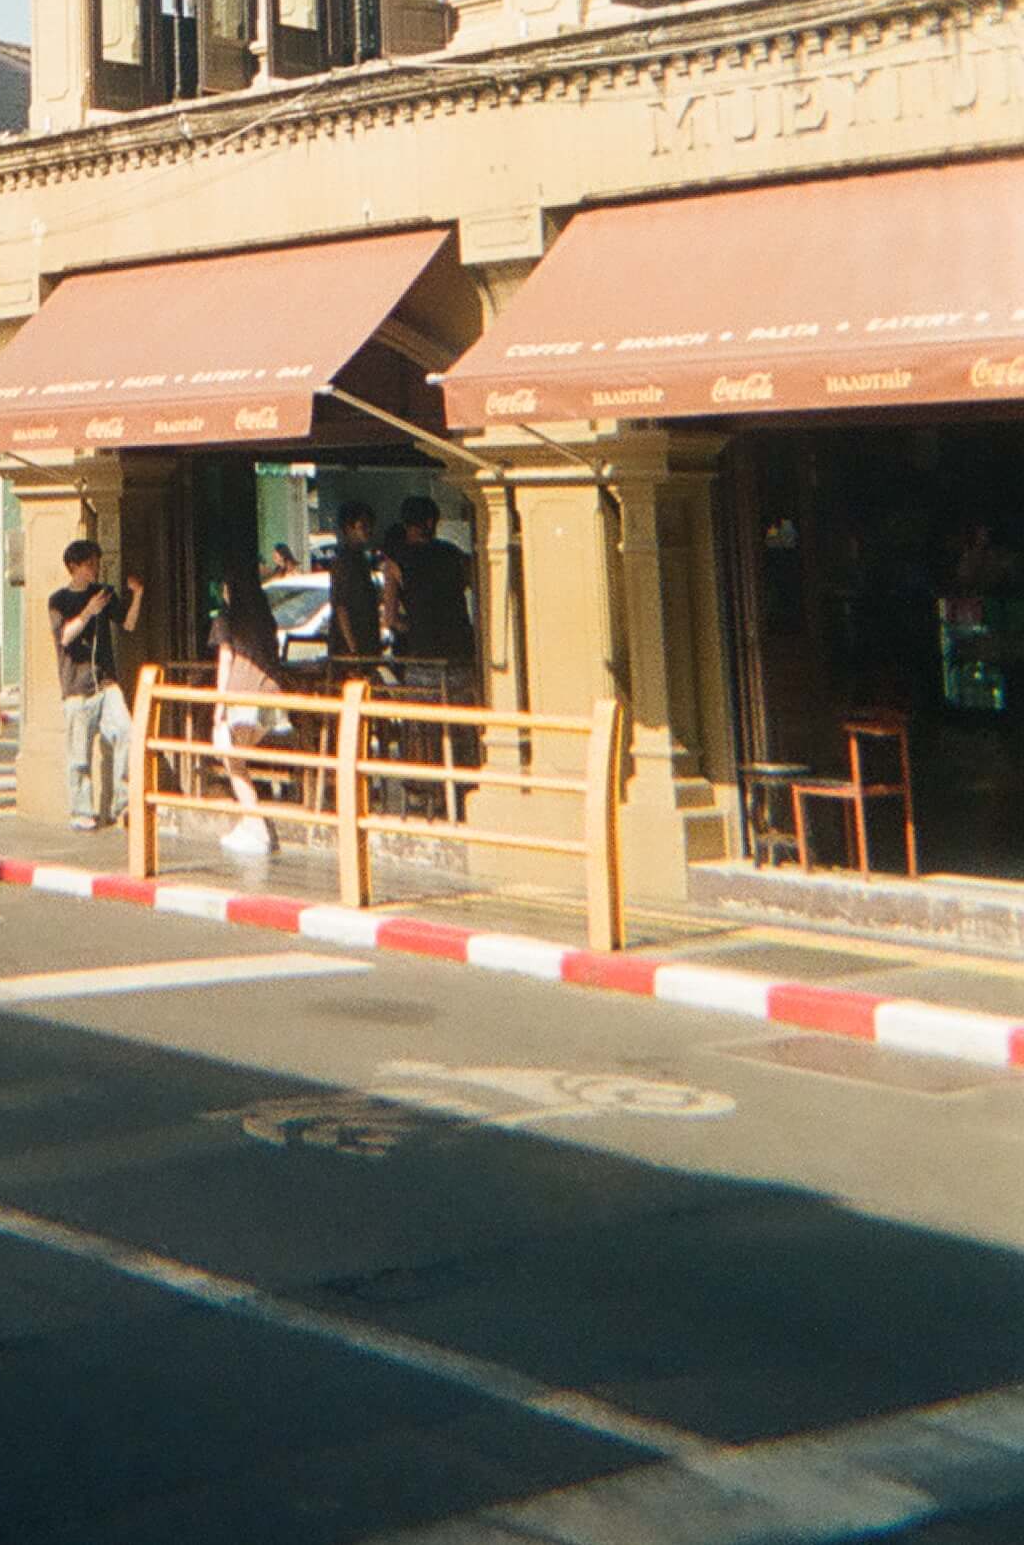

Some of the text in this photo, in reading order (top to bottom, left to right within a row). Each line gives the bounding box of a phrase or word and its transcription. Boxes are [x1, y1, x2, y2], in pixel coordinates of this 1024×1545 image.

[507, 312, 964, 357] COFFEE BRUNCH PASTA EATERY
